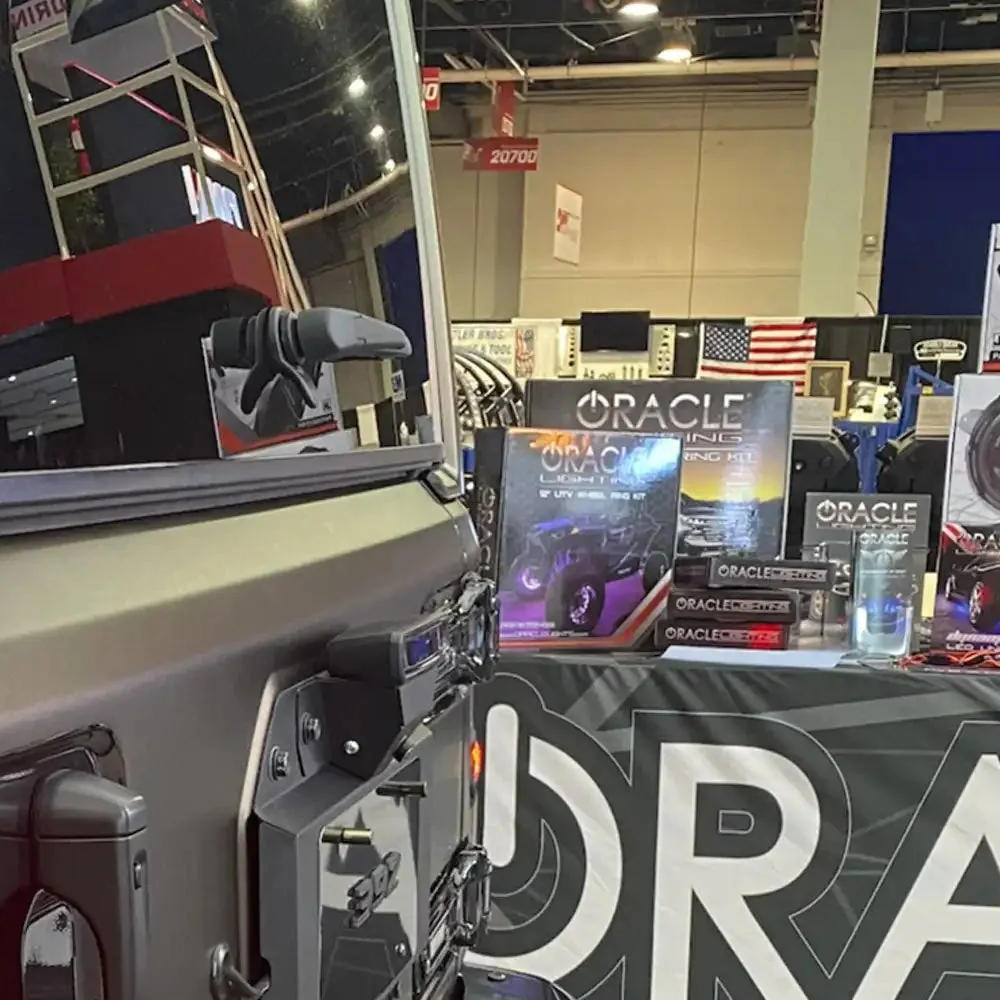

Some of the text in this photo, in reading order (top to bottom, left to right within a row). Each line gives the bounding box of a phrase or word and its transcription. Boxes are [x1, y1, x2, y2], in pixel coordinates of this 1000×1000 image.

[490, 150, 537, 164] 20700
[576, 390, 745, 430] ORACLE
[816, 499, 918, 524] ORACLE
[718, 564, 773, 579] ORACLE
[676, 597, 732, 611] ORACLE
[665, 627, 721, 641] ORACLE
